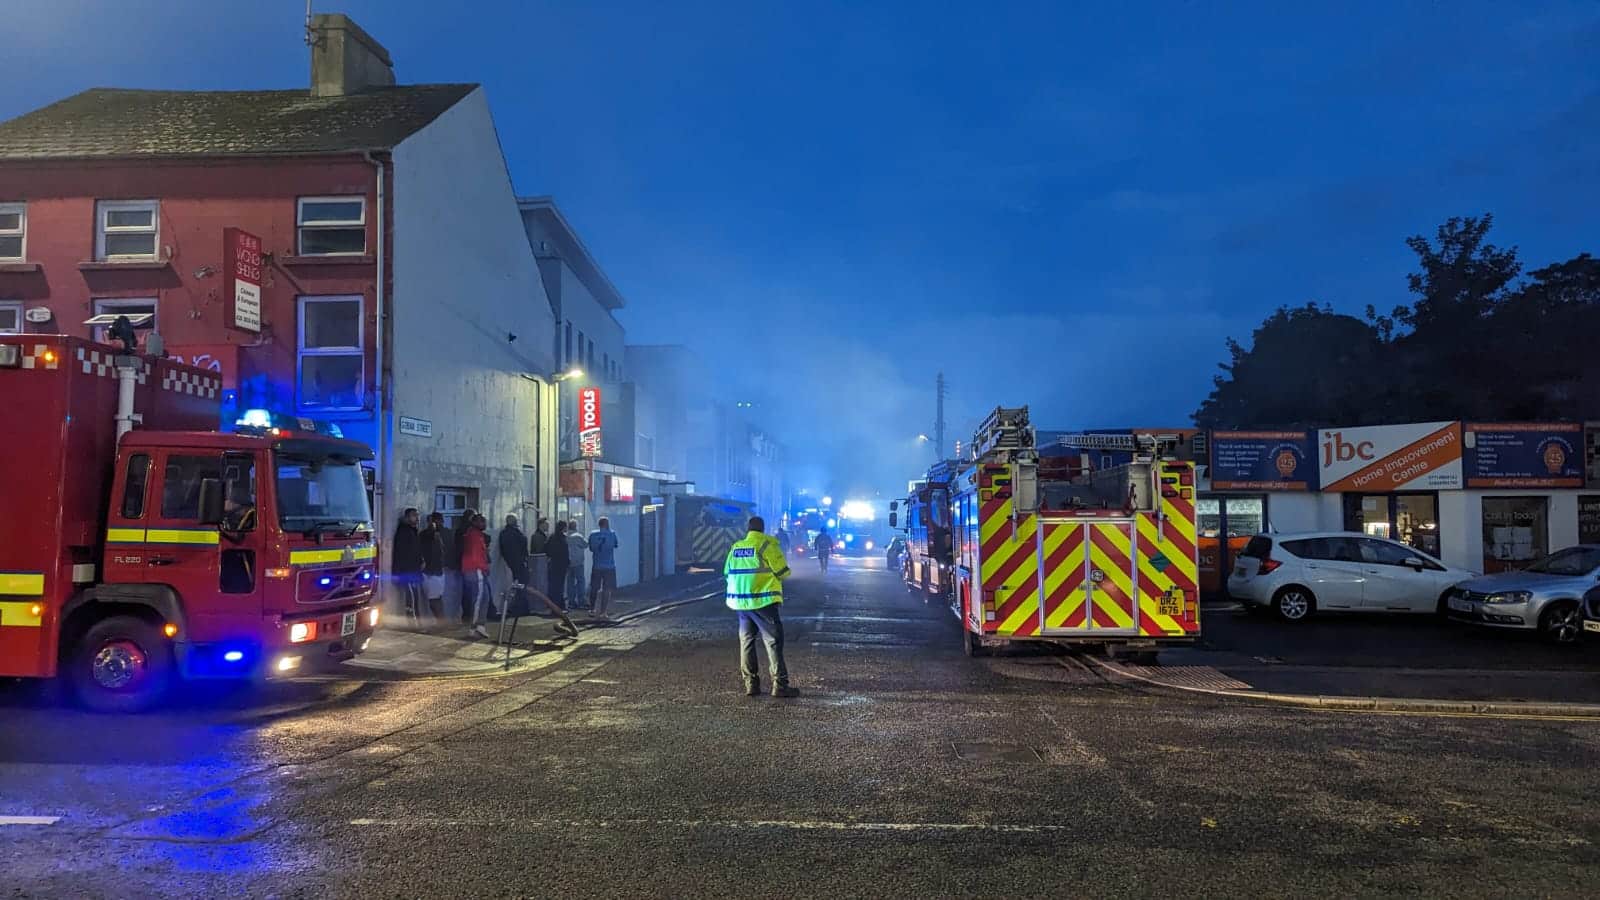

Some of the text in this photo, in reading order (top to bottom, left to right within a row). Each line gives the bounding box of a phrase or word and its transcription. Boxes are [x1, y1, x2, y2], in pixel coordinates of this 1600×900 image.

[583, 390, 596, 428] TOOLS
[1323, 432, 1375, 468] jbc
[1352, 468, 1385, 488] Home
[1384, 431, 1456, 472] Improvement
[1391, 461, 1428, 482] Centre
[1160, 597, 1177, 605] DRZ
[1160, 606, 1178, 615] 1676
